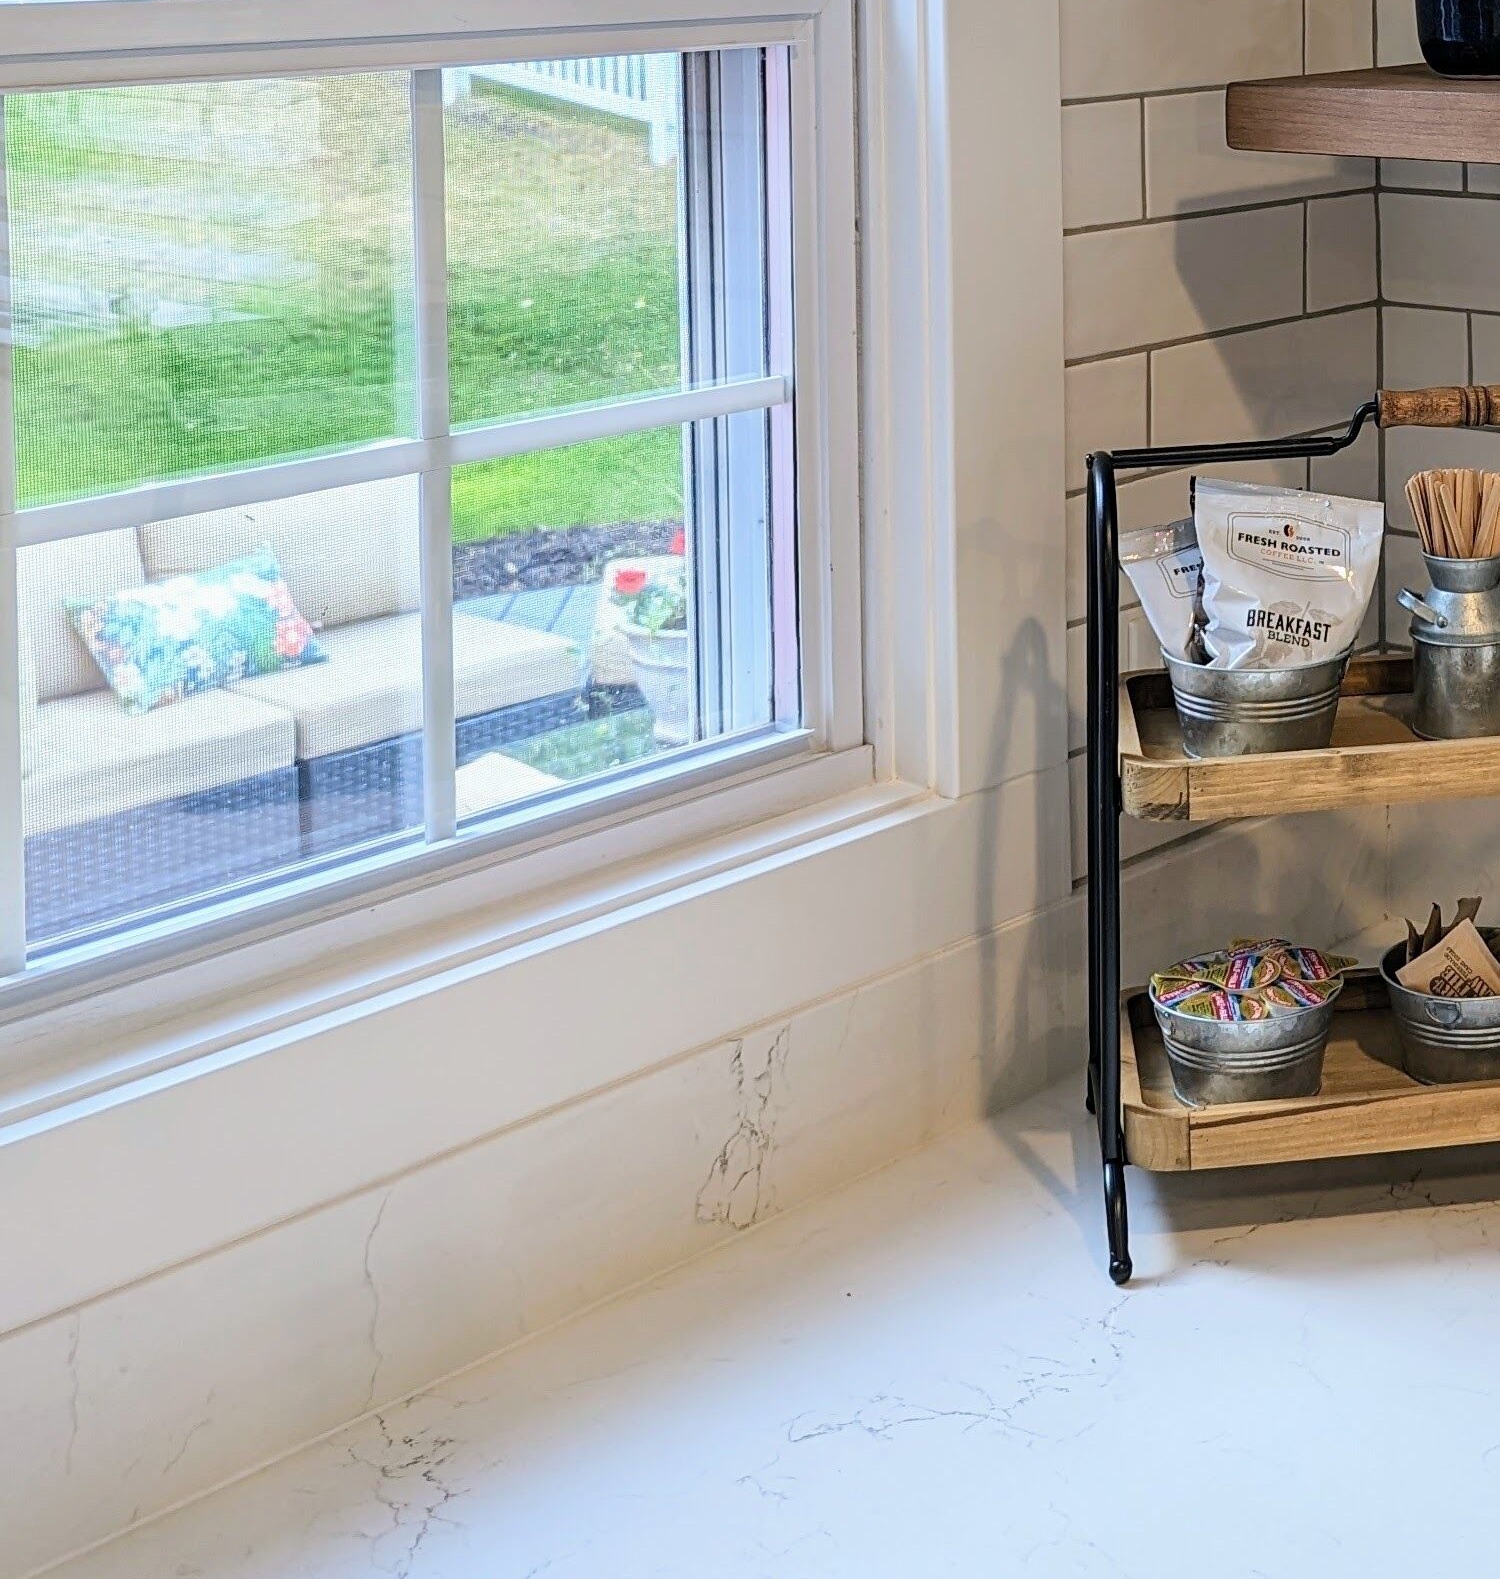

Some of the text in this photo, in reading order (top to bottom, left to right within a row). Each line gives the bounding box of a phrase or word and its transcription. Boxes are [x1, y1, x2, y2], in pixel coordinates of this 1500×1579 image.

[1237, 532, 1341, 557] FRESH ROASTED
[1260, 548, 1294, 560] COFFEE
[1246, 609, 1332, 643] BREAKFAST
[1267, 630, 1310, 648] BLEND
